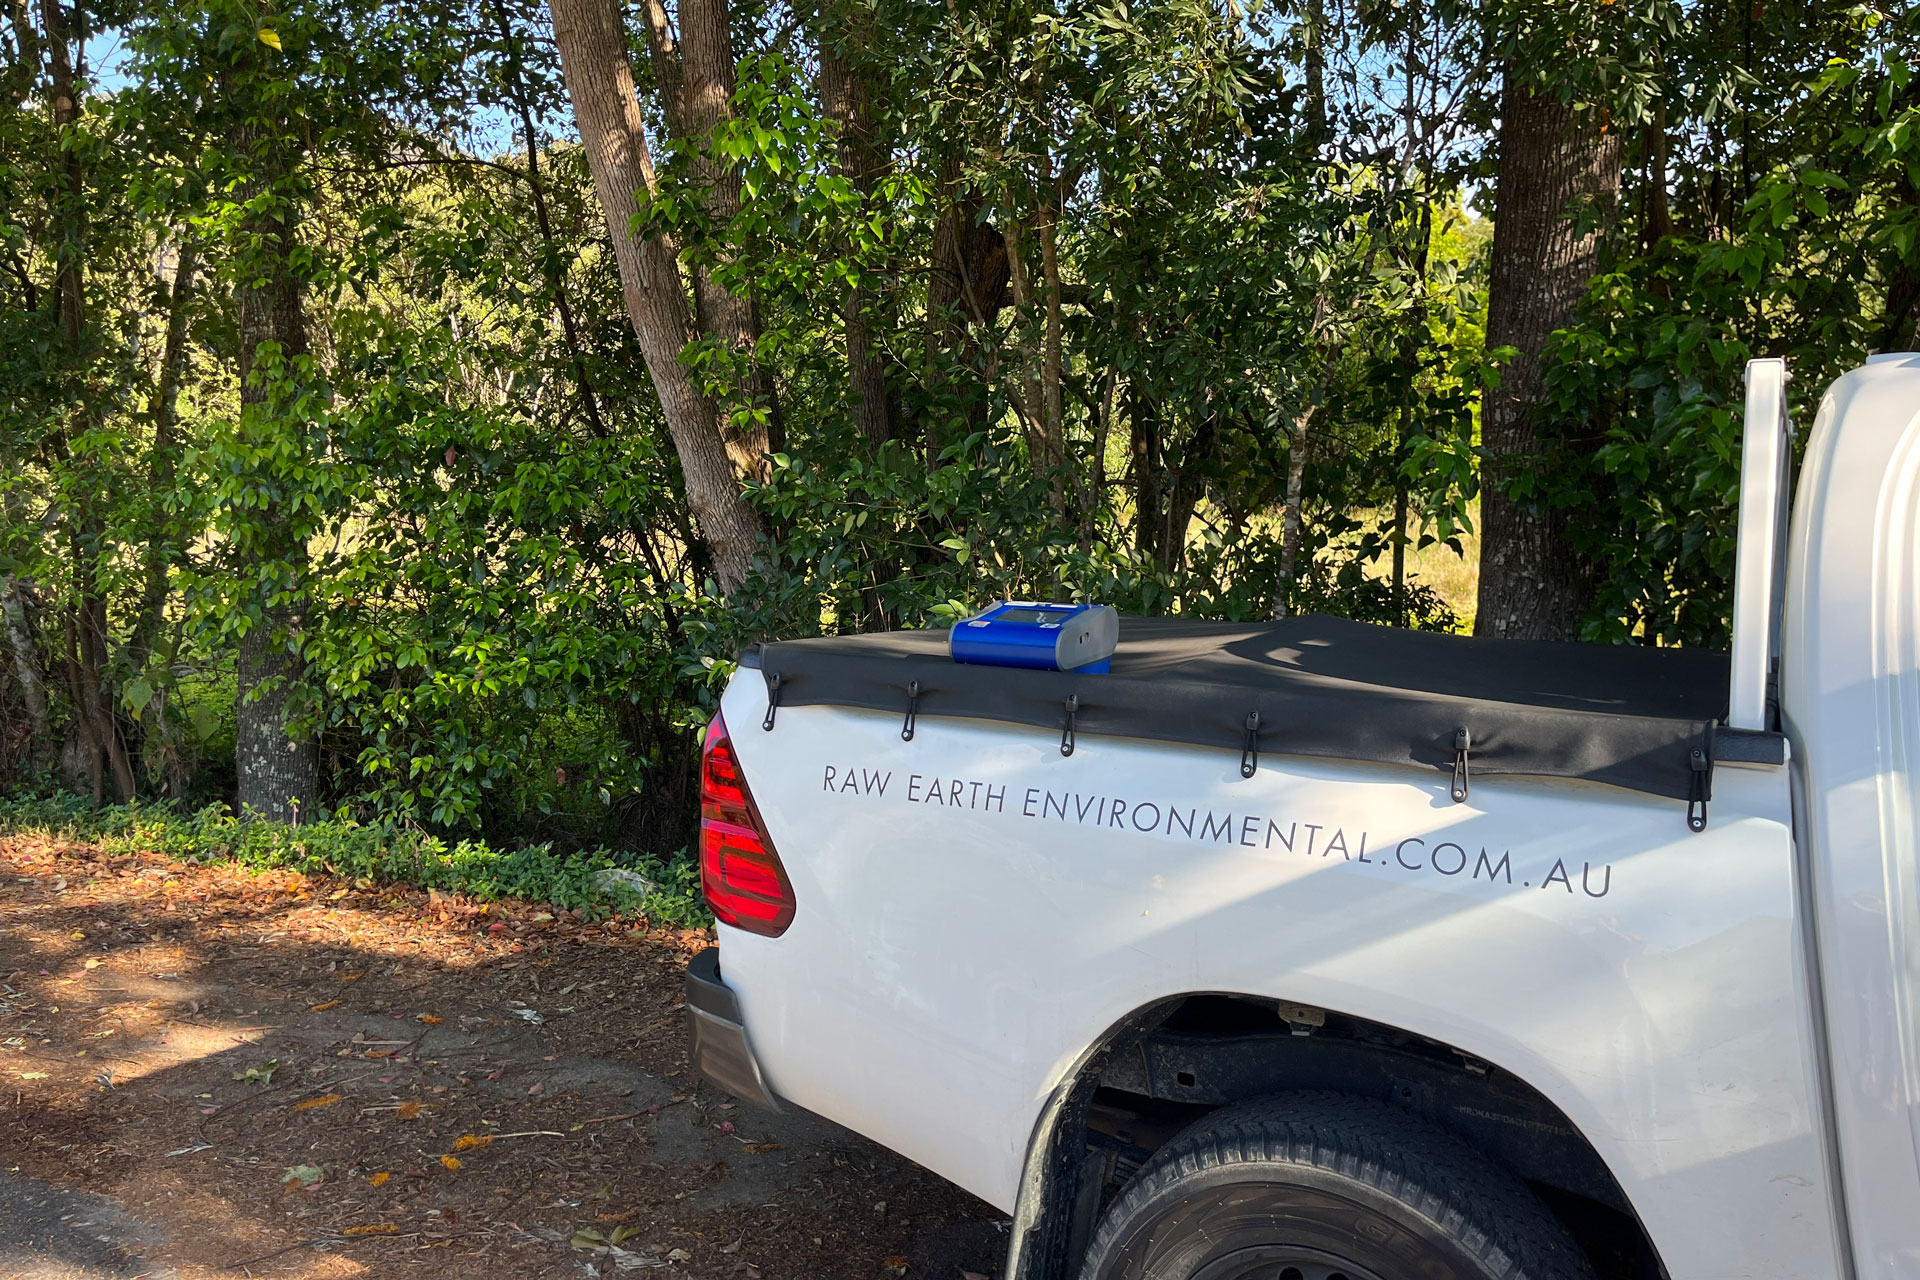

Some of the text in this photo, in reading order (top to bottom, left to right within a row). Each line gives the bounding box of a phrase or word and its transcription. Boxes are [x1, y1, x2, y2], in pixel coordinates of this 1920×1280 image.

[823, 765, 1611, 898] RAW EARTH ENVIRONMENTAL.COM.AU
